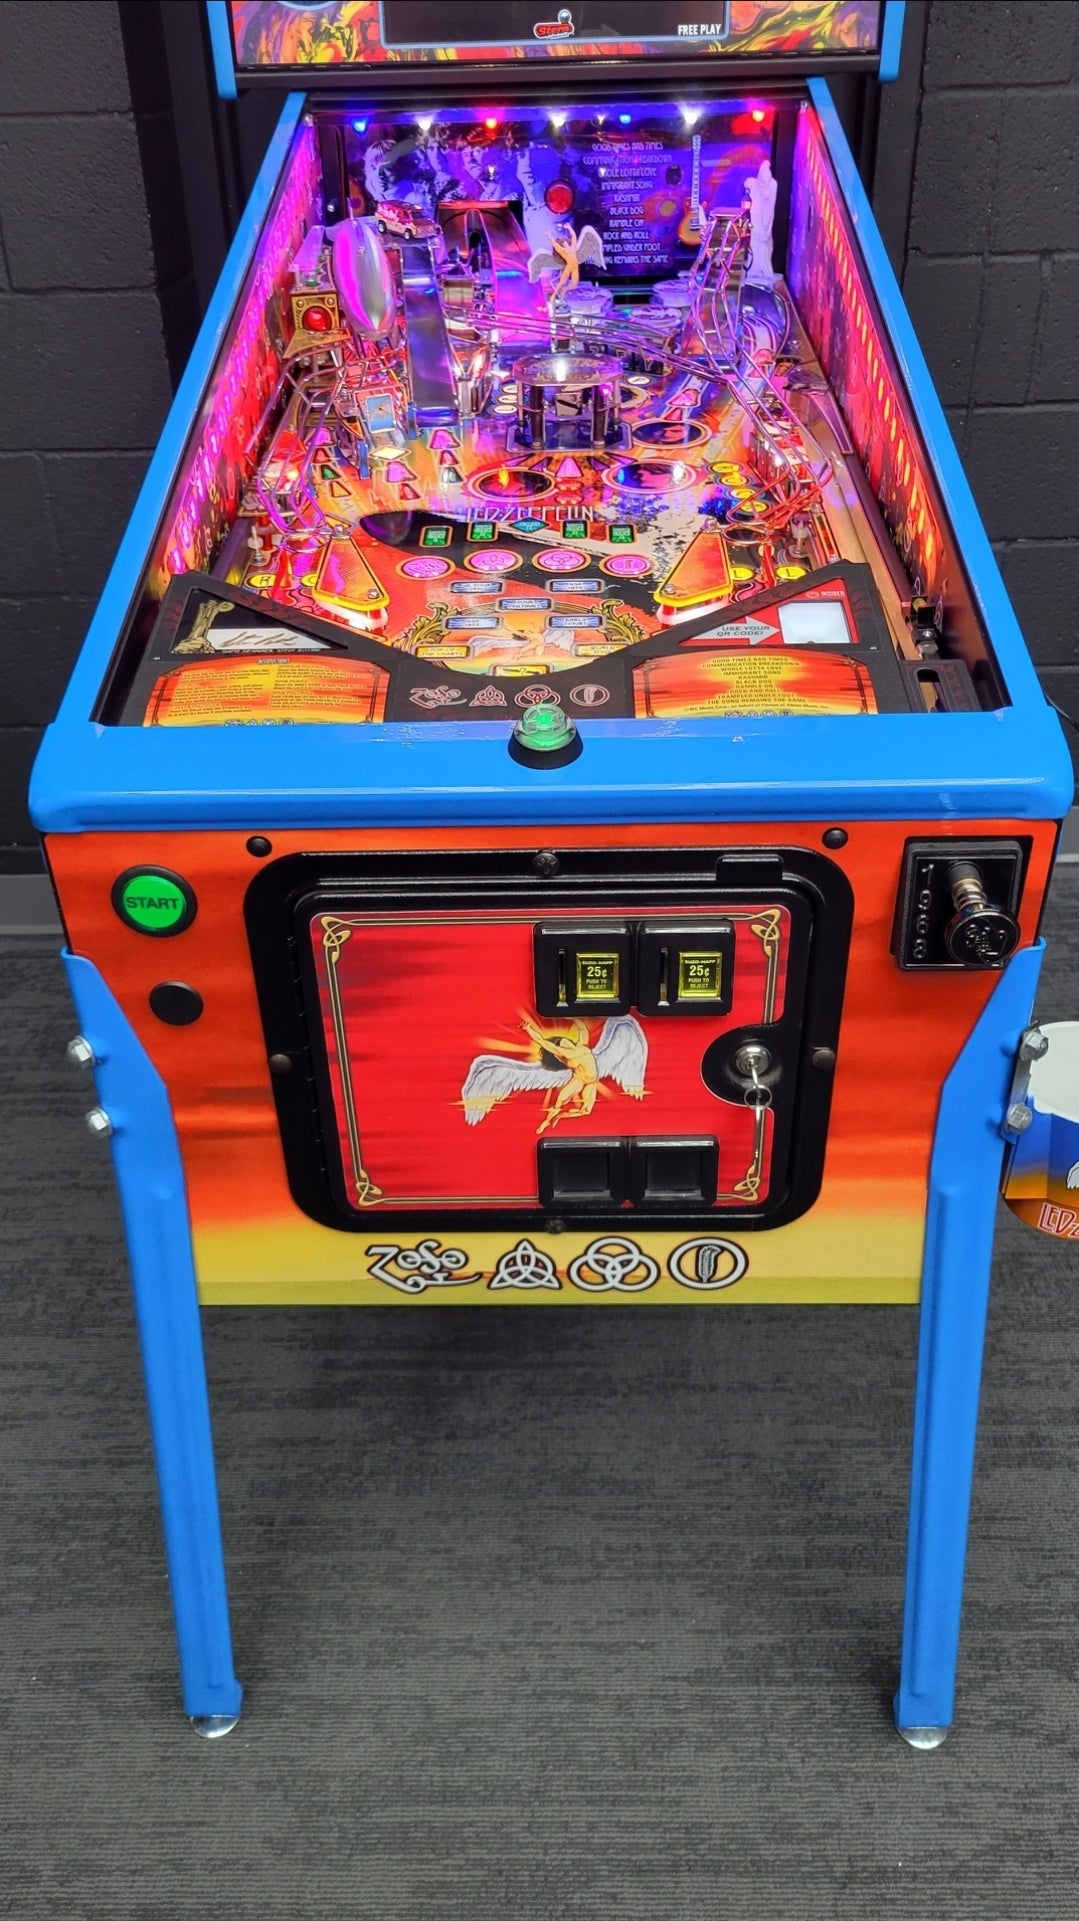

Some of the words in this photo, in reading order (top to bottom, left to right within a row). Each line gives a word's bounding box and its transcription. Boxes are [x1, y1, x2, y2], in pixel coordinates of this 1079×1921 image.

[677, 24, 699, 36] FREE
[700, 23, 722, 35] PLAY
[126, 896, 180, 911] START
[587, 966, 608, 979] 25¢
[689, 965, 710, 978] 25¢
